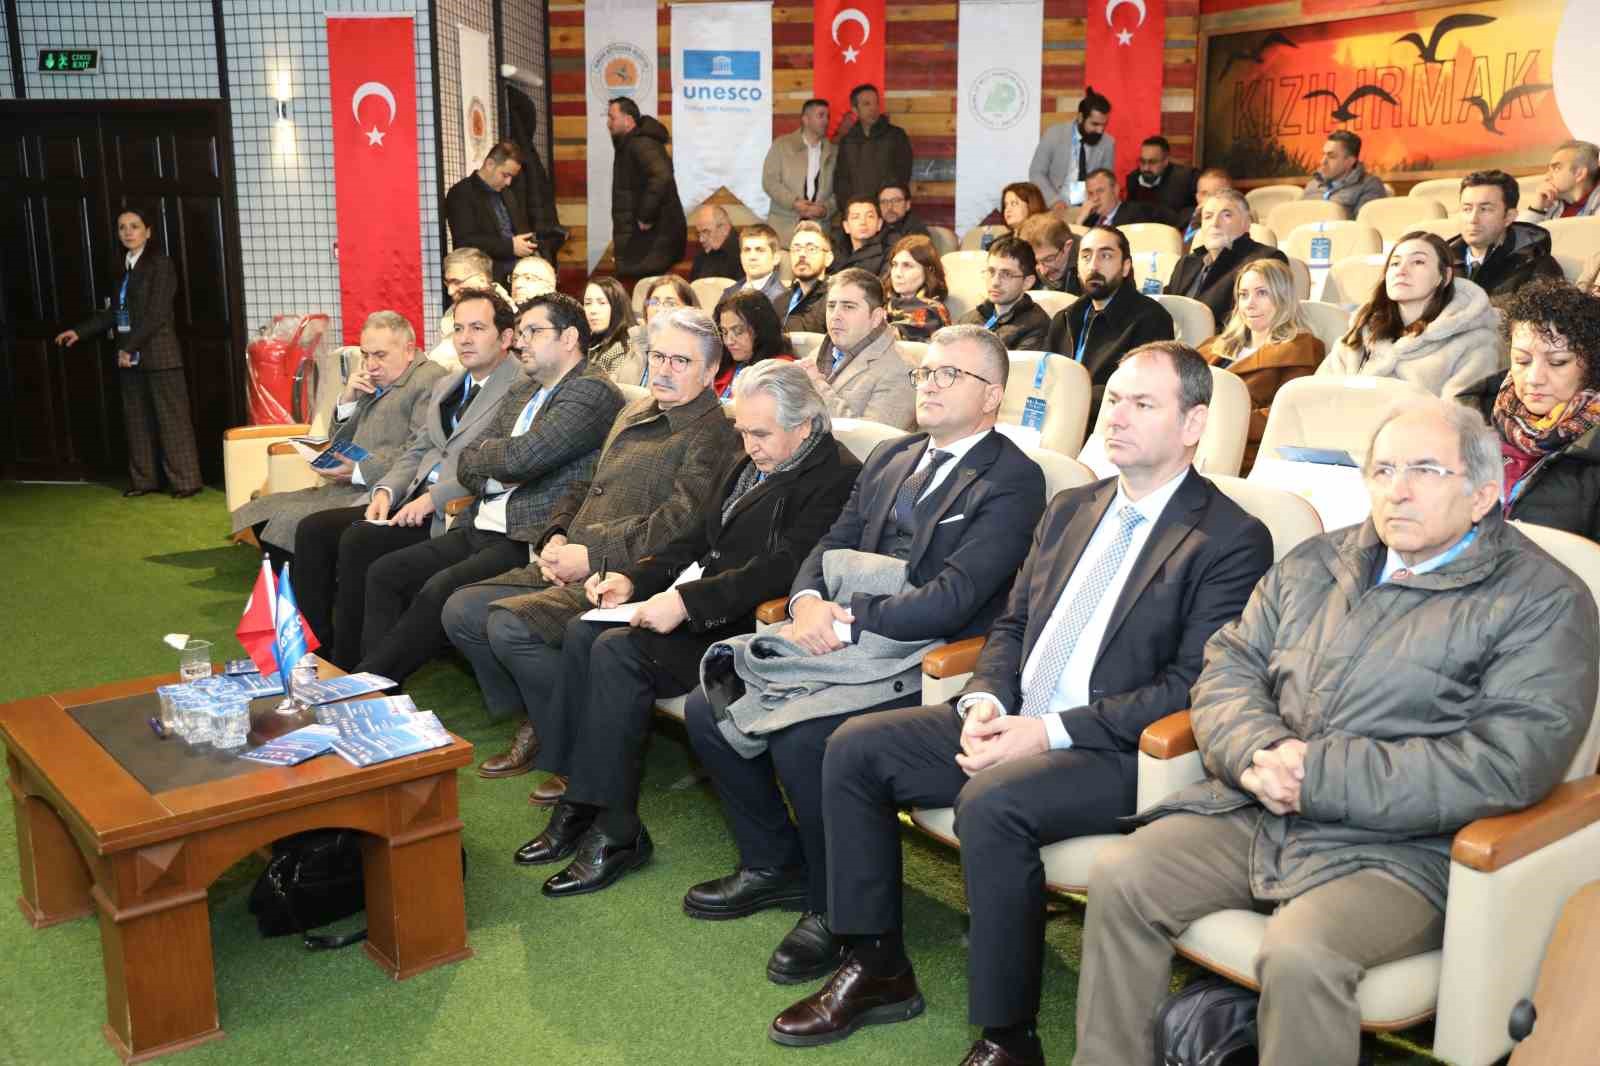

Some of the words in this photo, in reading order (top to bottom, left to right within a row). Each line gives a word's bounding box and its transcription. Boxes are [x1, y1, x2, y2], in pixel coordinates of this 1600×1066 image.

[72, 61, 89, 69] EXIT
[683, 86, 762, 101] unesco
[1233, 49, 1540, 140] KIZILIRMAK
